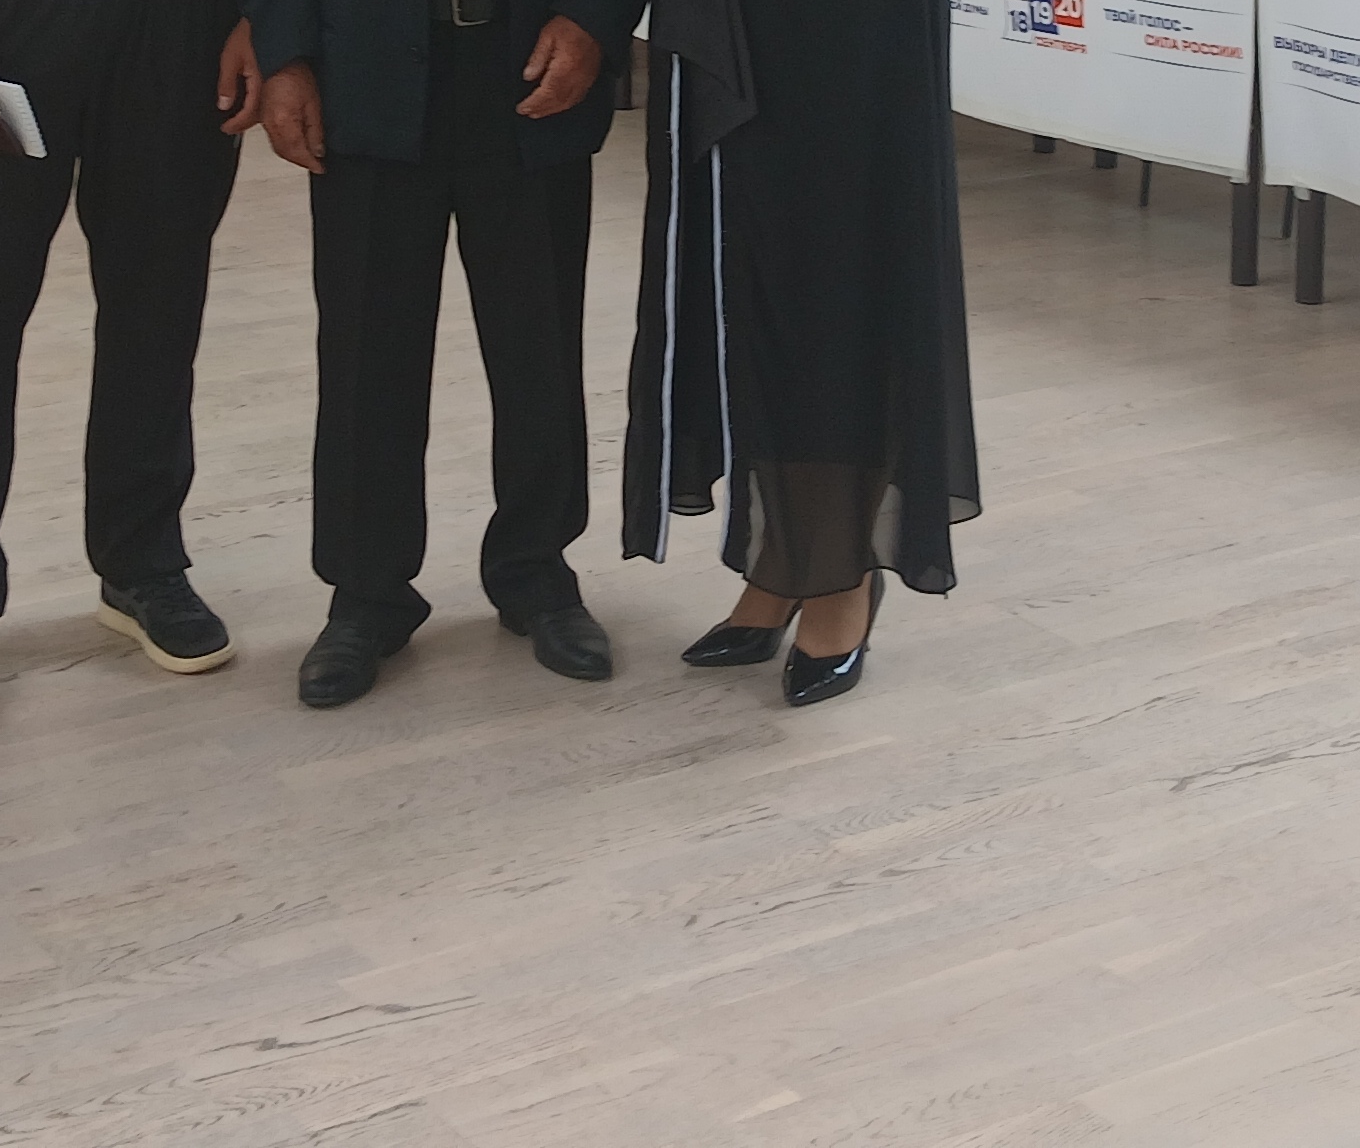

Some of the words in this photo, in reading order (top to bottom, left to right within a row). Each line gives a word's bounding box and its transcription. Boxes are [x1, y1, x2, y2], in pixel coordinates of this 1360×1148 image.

[1009, 10, 1029, 33] 18
[1031, 0, 1053, 25] 19
[1103, 8, 1137, 25] ТВОЙ
[1139, 13, 1181, 32] ГОЛОС
[1144, 33, 1180, 51] СИЛА
[1182, 39, 1244, 59] РОССИИ!
[1273, 35, 1327, 59] ВЫБОРЫ
